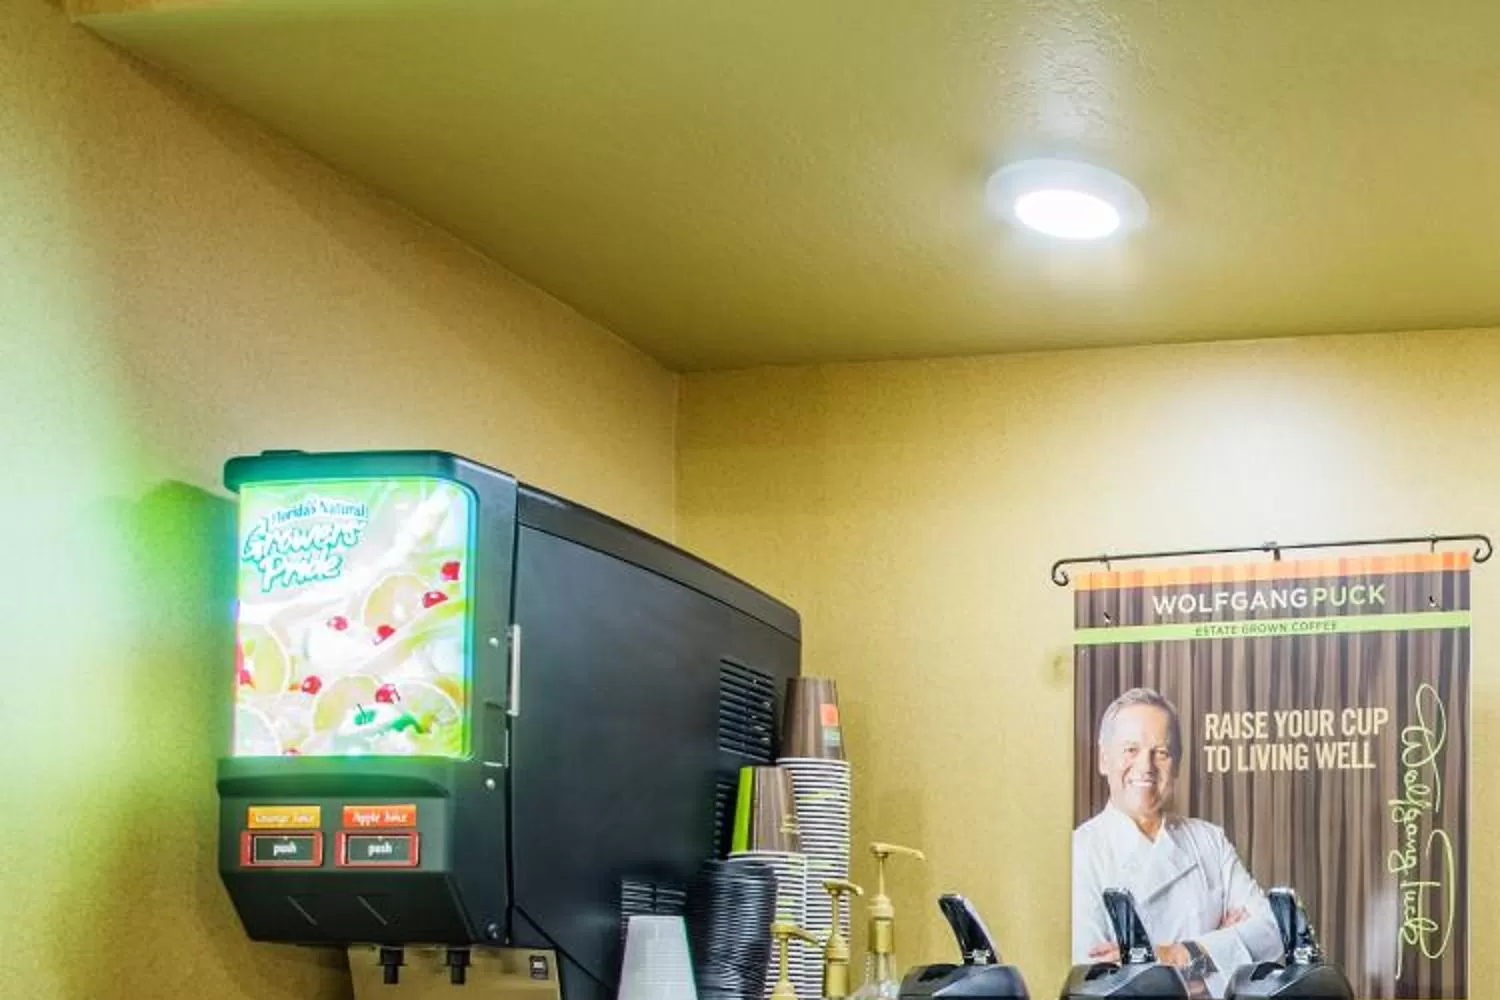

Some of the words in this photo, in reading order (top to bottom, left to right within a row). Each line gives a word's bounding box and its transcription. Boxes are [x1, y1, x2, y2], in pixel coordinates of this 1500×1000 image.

[1152, 588, 1308, 615] WOLFGANG
[1312, 583, 1386, 607] PUCK
[1195, 625, 1238, 637] ESTATE
[1241, 623, 1288, 635] GROWN
[1291, 620, 1338, 633] COFFEE
[1205, 711, 1269, 741] RAISE
[1273, 709, 1335, 738] YOUR
[1341, 707, 1389, 736] CUP
[1203, 745, 1231, 773] TO
[1237, 743, 1309, 773] LIVING
[1315, 741, 1377, 770] WELL
[352, 812, 380, 826] Apple
[383, 811, 409, 823] Juice
[273, 842, 297, 856] push
[367, 842, 393, 857] push
